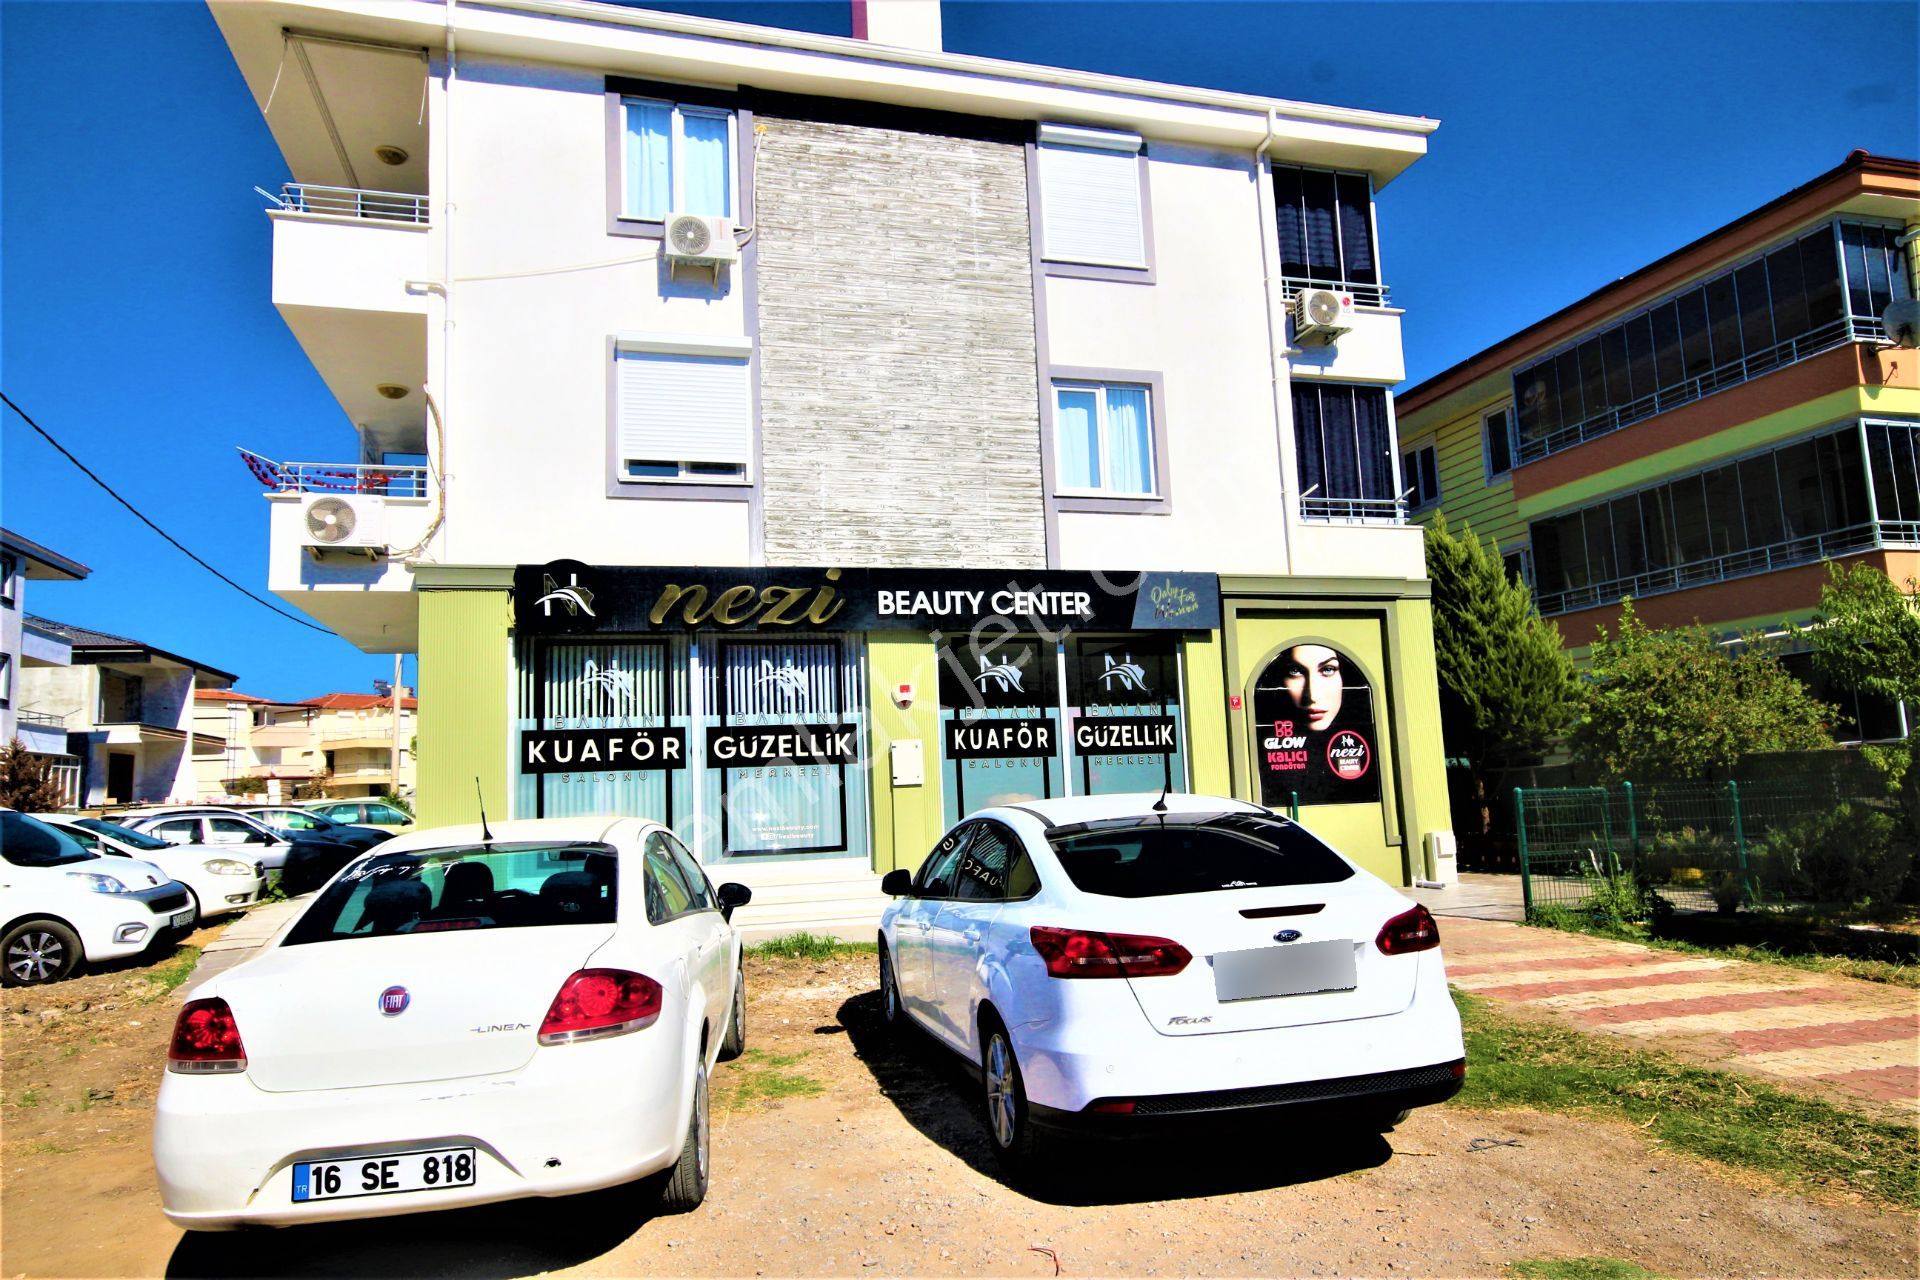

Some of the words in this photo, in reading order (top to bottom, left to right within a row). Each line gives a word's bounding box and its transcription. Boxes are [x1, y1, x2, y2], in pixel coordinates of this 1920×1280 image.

[649, 567, 846, 626] nezi
[877, 590, 985, 616] BEAUTY
[990, 591, 1091, 616] CENTER
[735, 709, 829, 726] BAYAN
[964, 705, 1038, 720] BAYAN
[1091, 702, 1160, 717] BAYAN
[554, 713, 656, 730] BAYAN
[1274, 720, 1294, 738] BB
[954, 722, 1049, 750] KUAFÖR
[1077, 724, 1174, 748] GÜZELLİK
[1264, 736, 1307, 750] GLOW
[528, 731, 680, 763] KUAFÖR
[713, 732, 853, 760] GÜZELLİK
[1330, 744, 1365, 758] nezi
[969, 757, 1042, 769] SALONU
[561, 770, 648, 784] SALONU
[385, 994, 404, 1009] FIAT
[470, 1023, 531, 1034] LINEA
[312, 1165, 341, 1196] 16
[361, 1159, 399, 1191] SE
[423, 1153, 471, 1185] 818
[296, 1185, 308, 1193] TR
